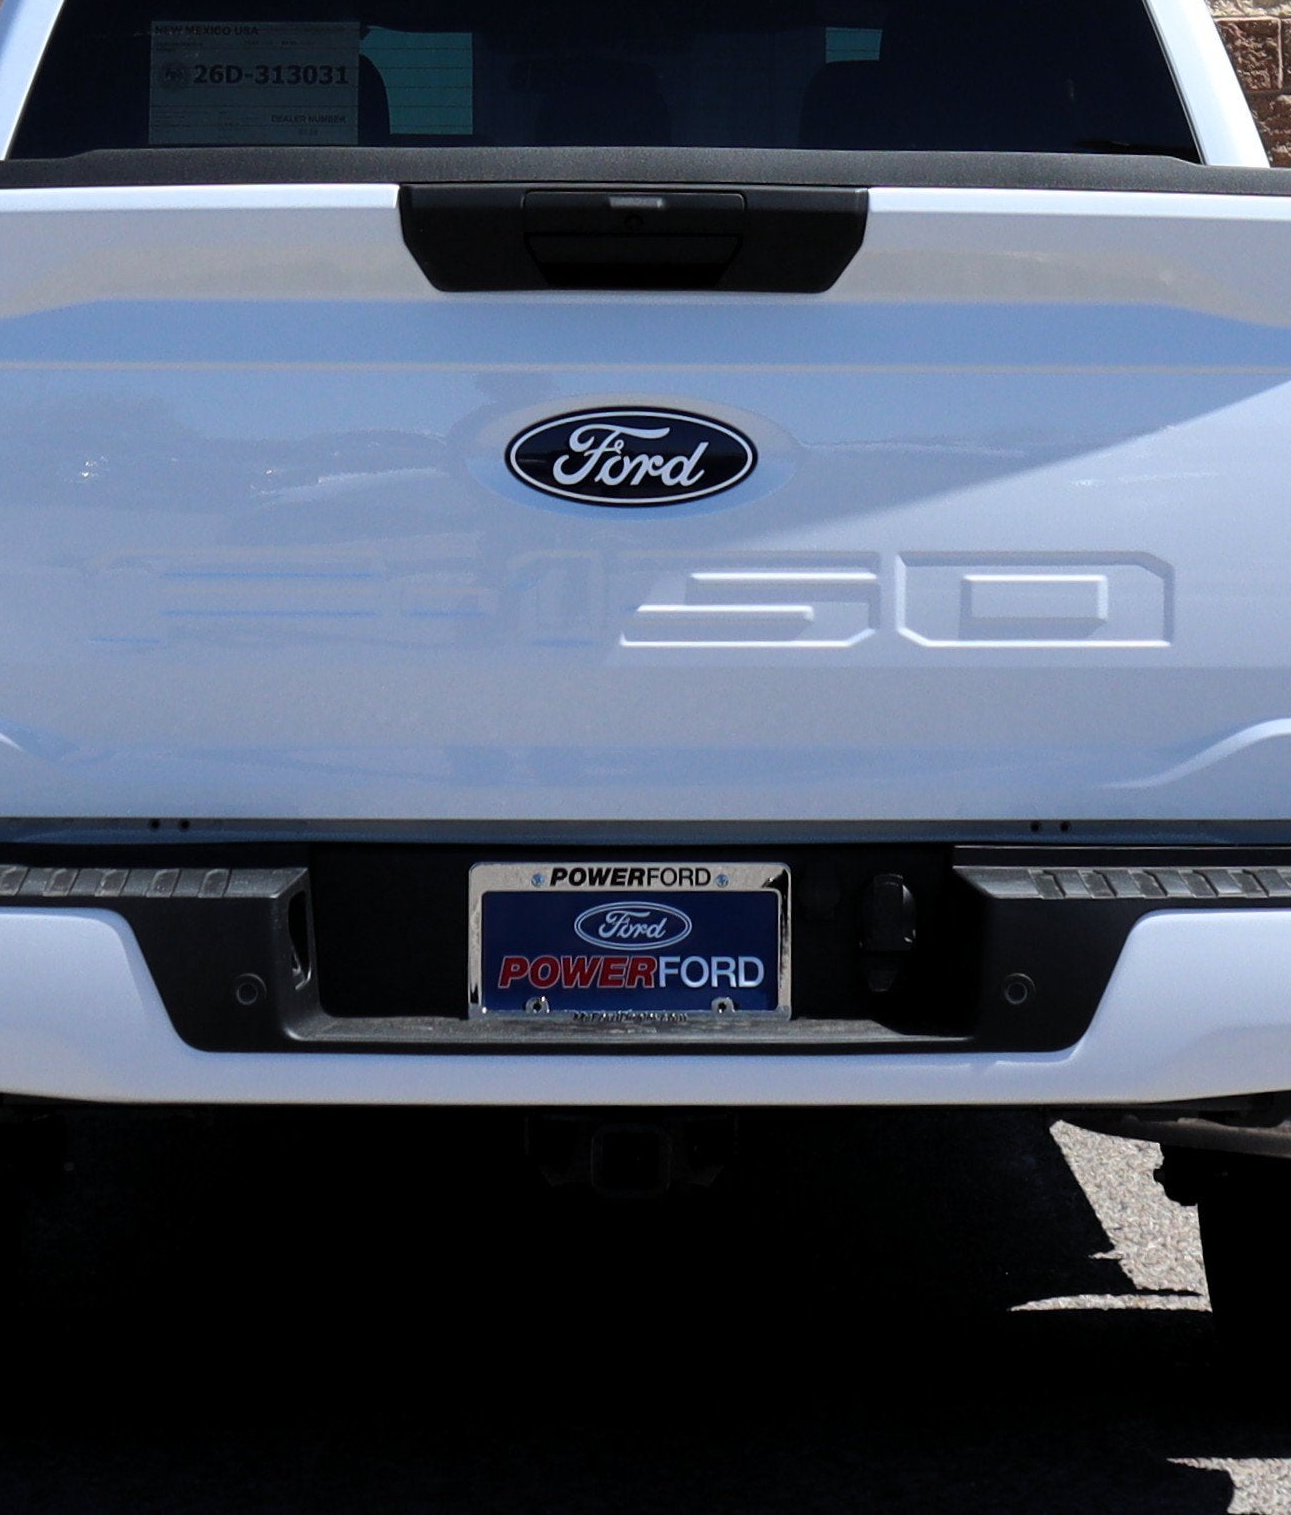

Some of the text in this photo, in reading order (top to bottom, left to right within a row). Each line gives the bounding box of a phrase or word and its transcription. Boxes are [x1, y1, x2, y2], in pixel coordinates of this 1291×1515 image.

[155, 25, 259, 35] NEW MEXICO USA
[193, 64, 349, 85] 26D-313031
[271, 114, 347, 124] DEALER NUMBER
[552, 423, 709, 487] Ford
[549, 867, 712, 887] POWERFORD
[598, 910, 668, 939] Ford
[498, 955, 765, 990] POWERFORD
